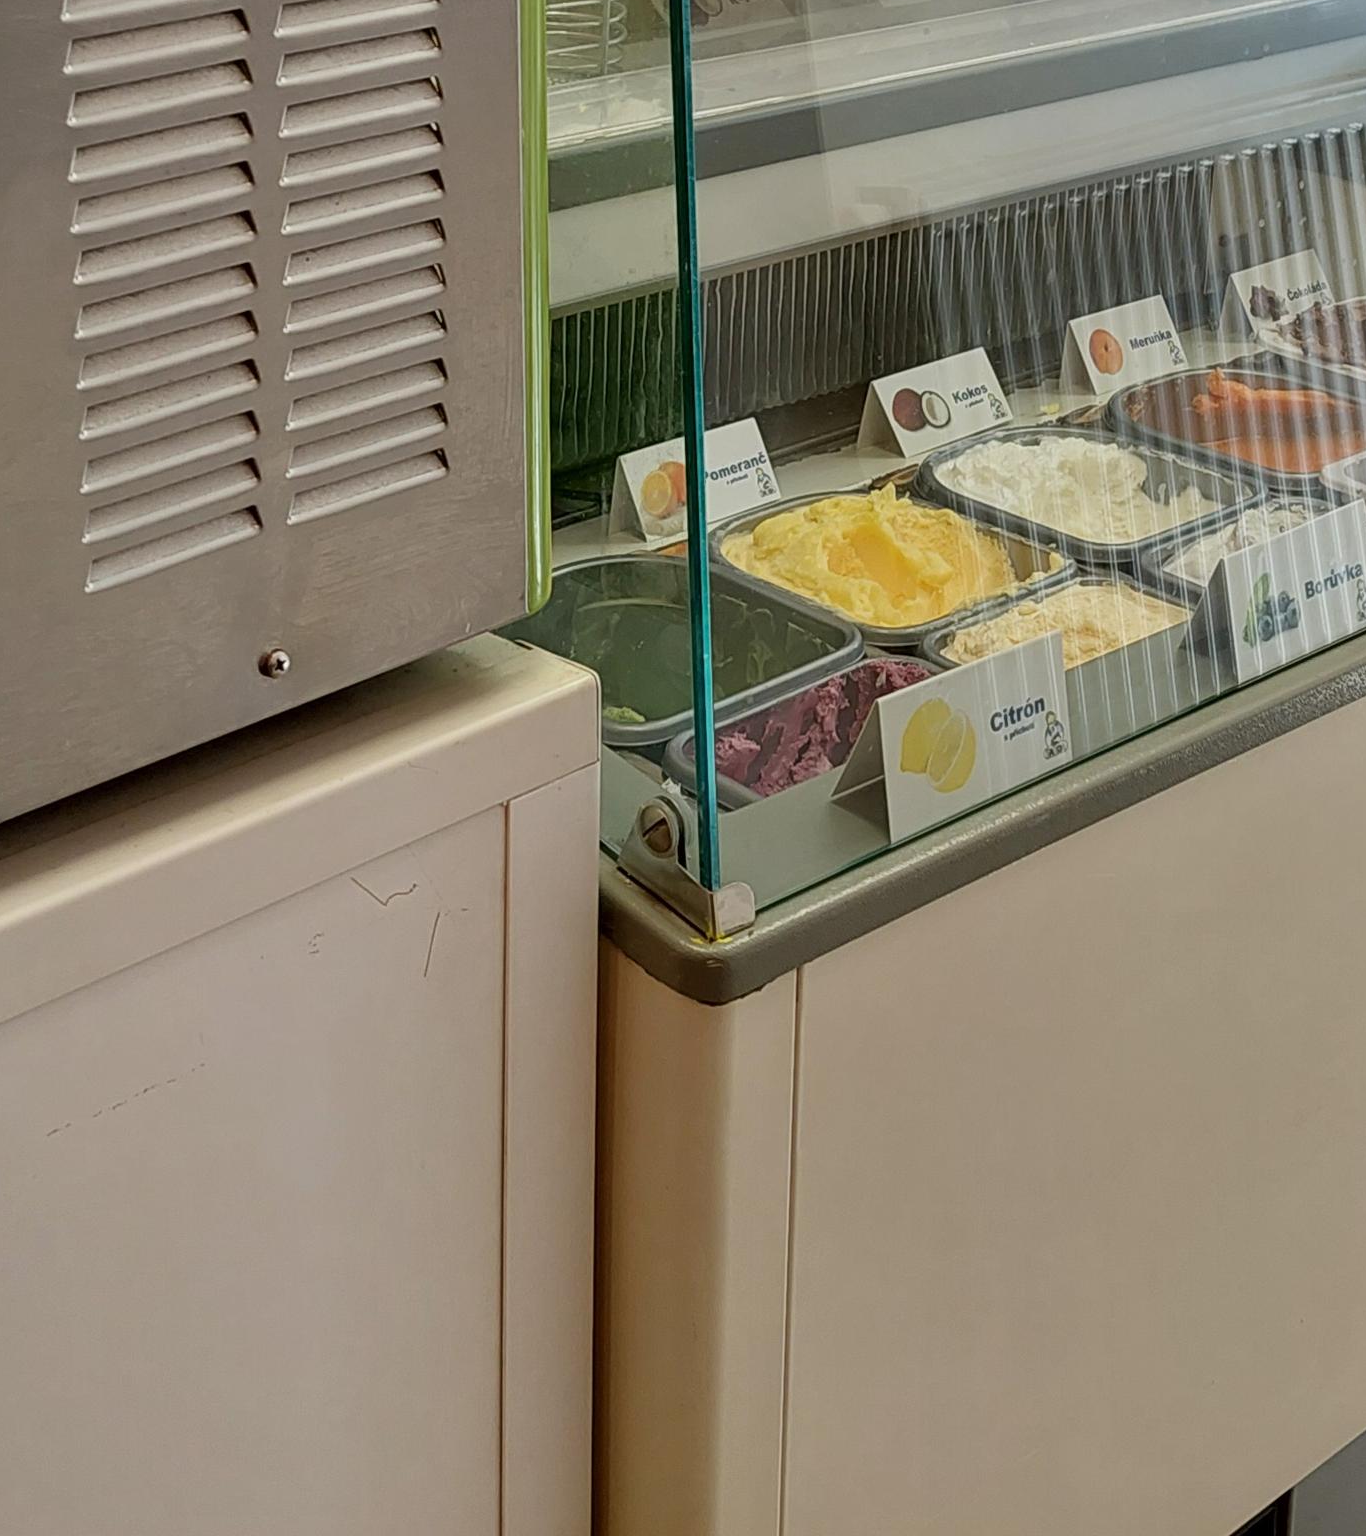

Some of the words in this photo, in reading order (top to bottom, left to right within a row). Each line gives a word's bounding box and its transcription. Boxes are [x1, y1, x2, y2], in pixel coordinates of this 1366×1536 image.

[1129, 329, 1173, 351] Meruňka
[951, 384, 989, 404] Kokos
[1304, 563, 1364, 599] Borůvka
[990, 696, 1046, 732] Citrón
